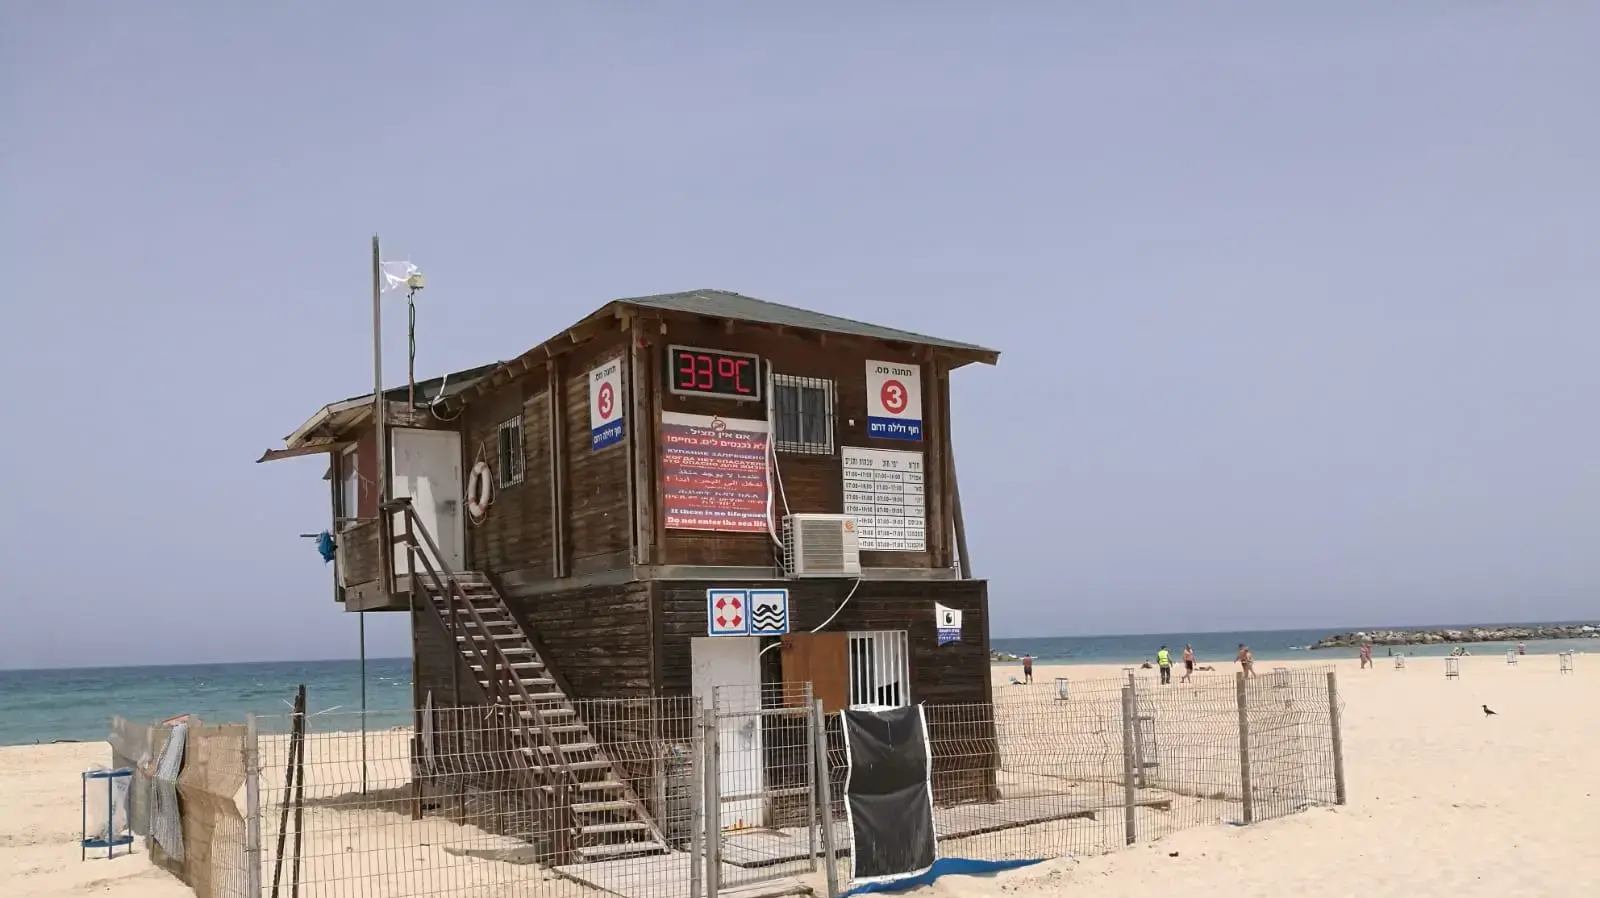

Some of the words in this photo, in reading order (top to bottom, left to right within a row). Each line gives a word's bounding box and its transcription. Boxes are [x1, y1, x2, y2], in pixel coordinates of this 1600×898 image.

[892, 368, 912, 376] תחנה
[601, 388, 611, 413] 3
[886, 386, 902, 408] 3
[888, 422, 906, 433] דלילה
[908, 426, 919, 436] חוף
[721, 441, 751, 449] נכנסים
